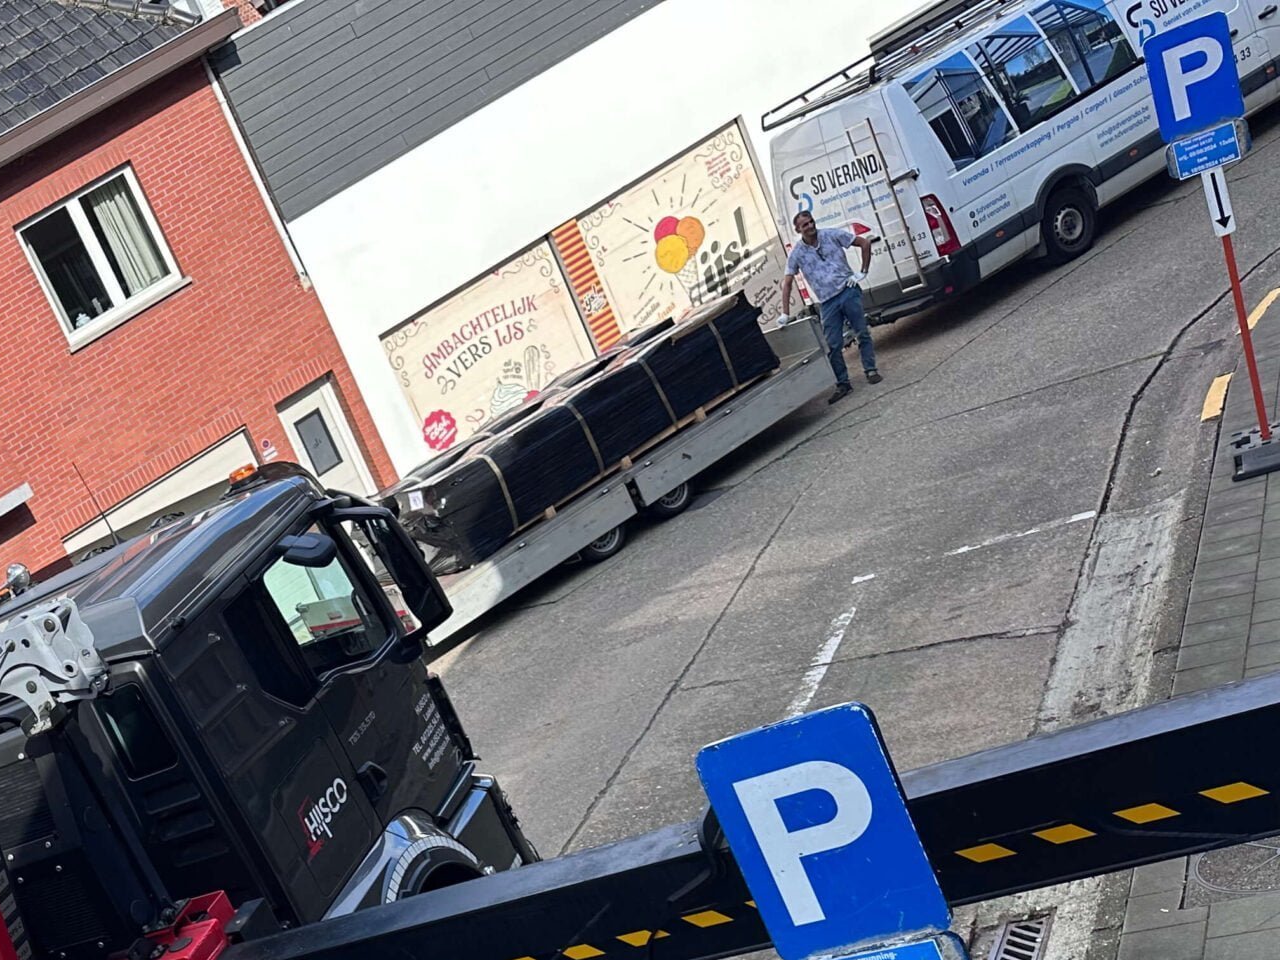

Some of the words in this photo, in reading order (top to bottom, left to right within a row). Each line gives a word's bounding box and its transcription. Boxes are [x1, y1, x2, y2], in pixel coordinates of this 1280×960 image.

[1240, 46, 1251, 61] 33
[1162, 36, 1224, 122] P
[961, 167, 989, 187] Veranda
[1056, 114, 1079, 132] Pergola
[1084, 99, 1108, 116] Carport
[810, 174, 827, 195] SD
[916, 231, 927, 240] 33
[422, 294, 538, 379] AMBACHTELIJK
[494, 321, 524, 347] IJS
[446, 336, 492, 378] VERS
[732, 760, 873, 927] P
